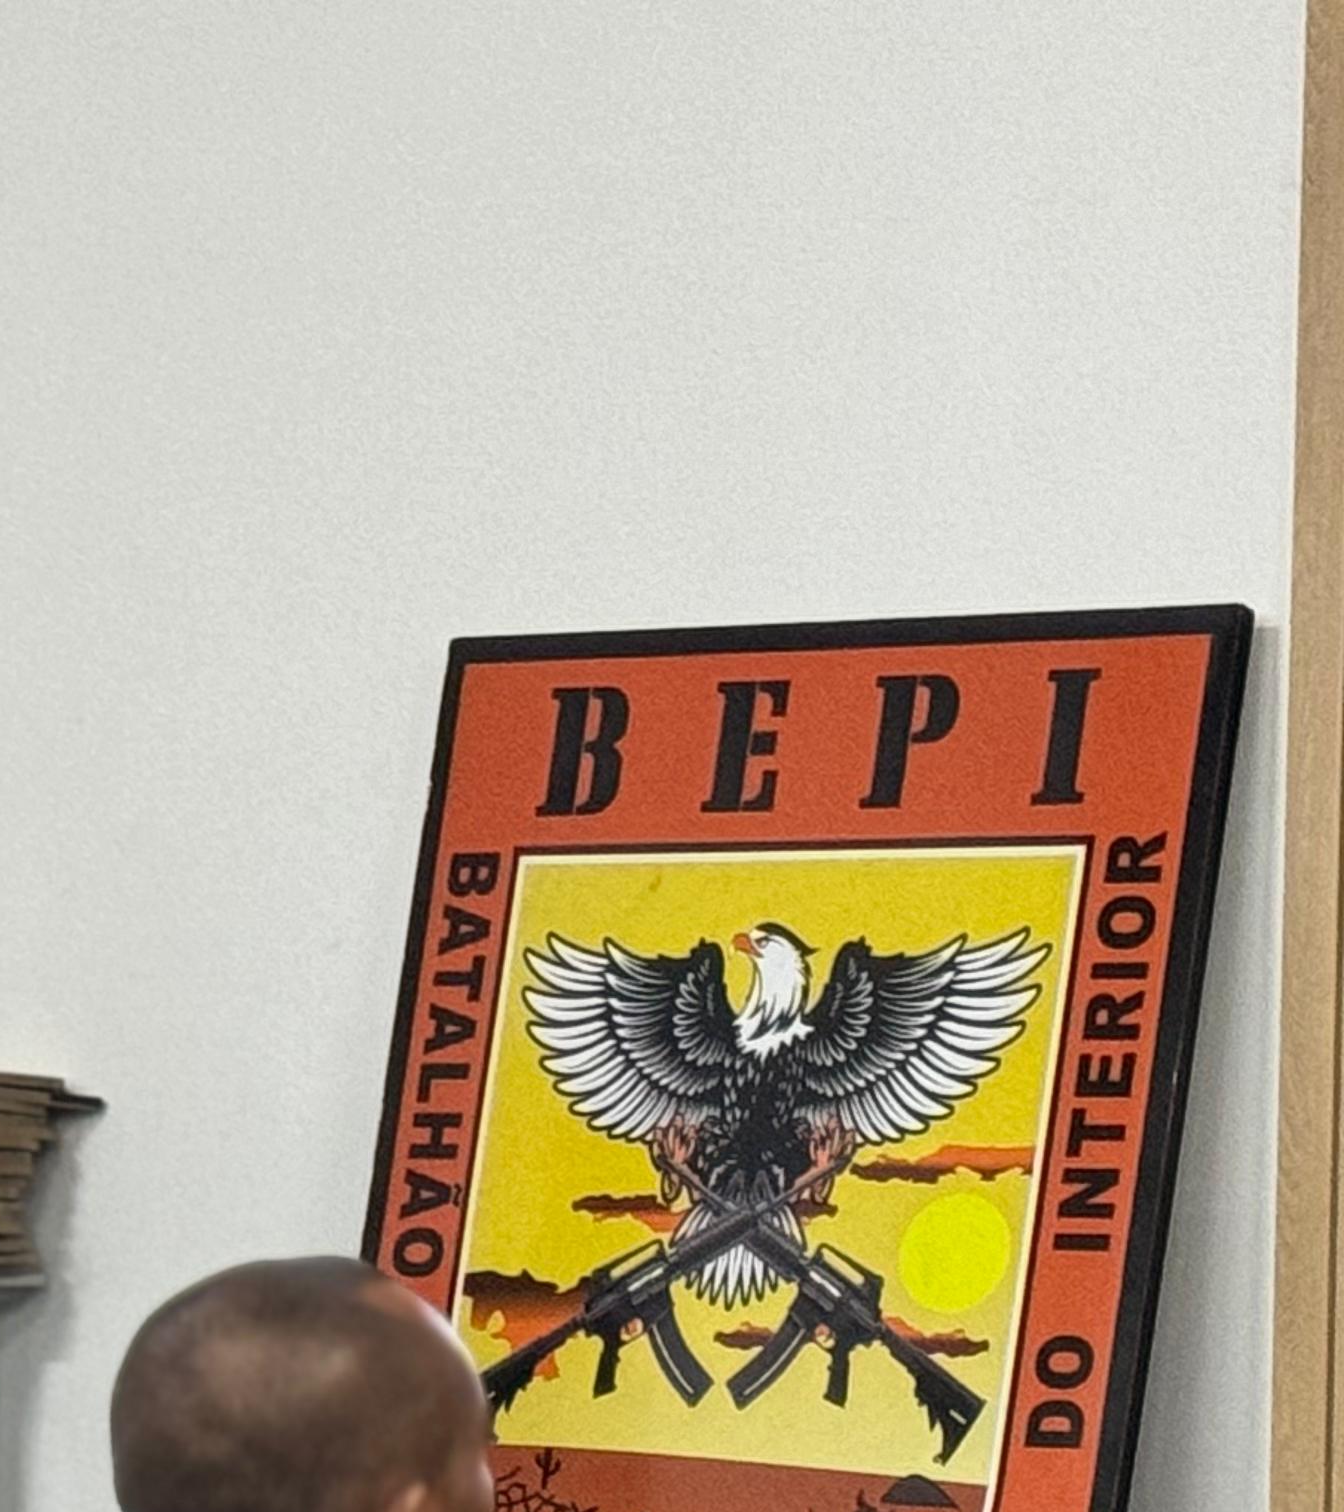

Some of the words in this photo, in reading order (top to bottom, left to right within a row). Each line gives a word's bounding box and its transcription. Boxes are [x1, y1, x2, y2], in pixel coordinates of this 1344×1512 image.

[535, 667, 1103, 817] BEPI
[393, 852, 501, 1278] BATALHÃO
[1053, 830, 1169, 1252] INTERIOR
[1024, 1334, 1095, 1449] DO
